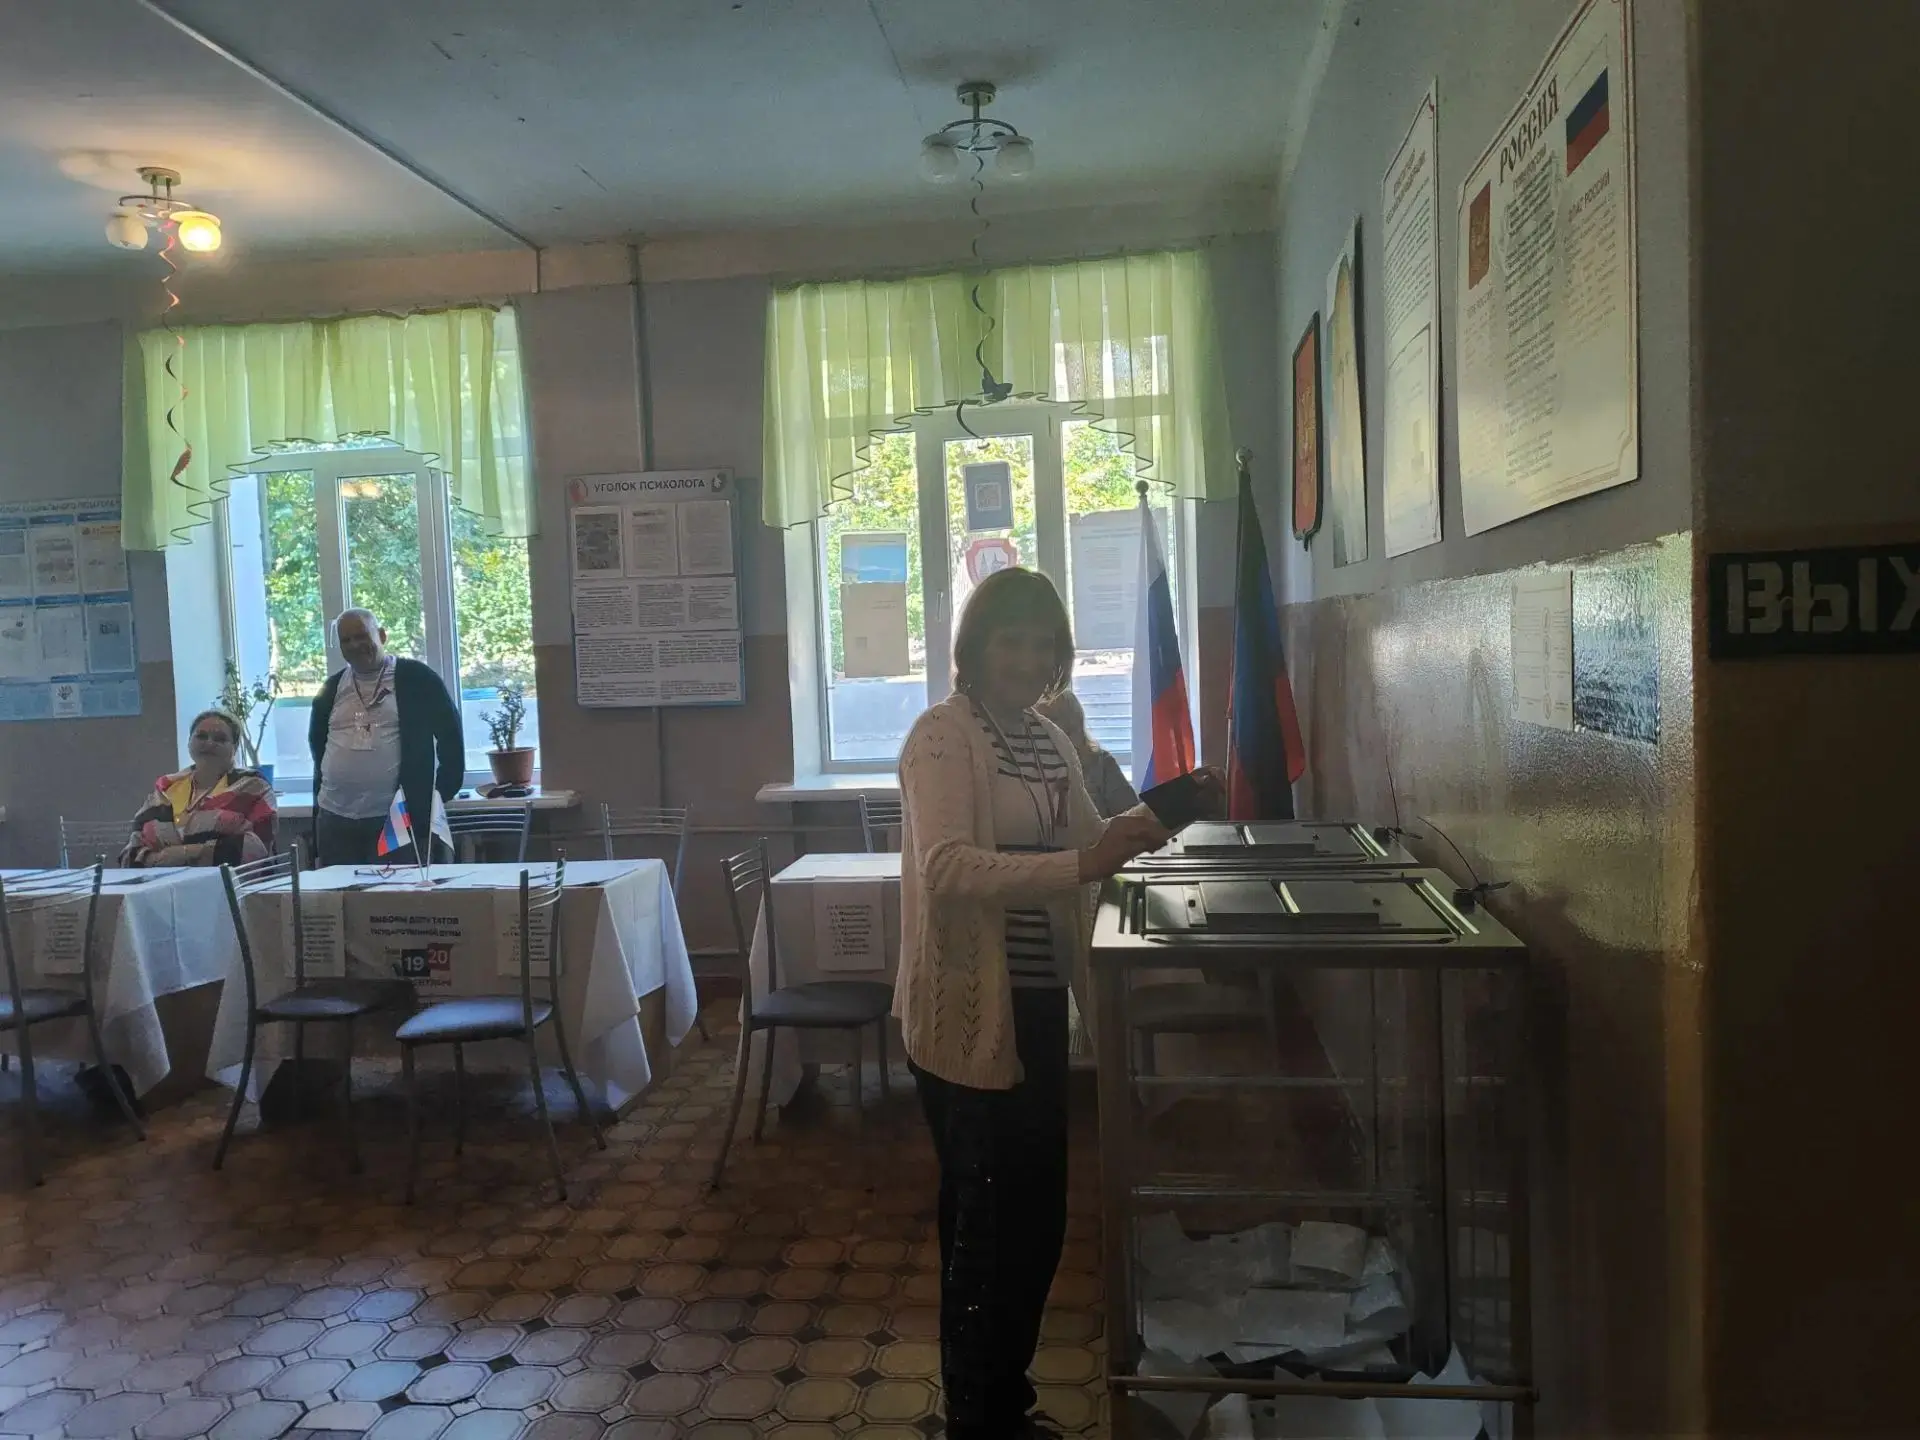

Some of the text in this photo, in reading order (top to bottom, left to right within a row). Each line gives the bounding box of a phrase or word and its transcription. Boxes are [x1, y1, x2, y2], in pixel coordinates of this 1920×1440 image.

[1498, 74, 1560, 187] РОССИЯ
[594, 479, 705, 493] УГОЛОК ПСИХОЛОГА
[369, 915, 459, 925] ВЫБОРЫ ДУТАТОВ
[370, 928, 438, 937] ГОСУДАРСТННОЙ
[404, 956, 425, 971] 19
[427, 949, 449, 964] 20
